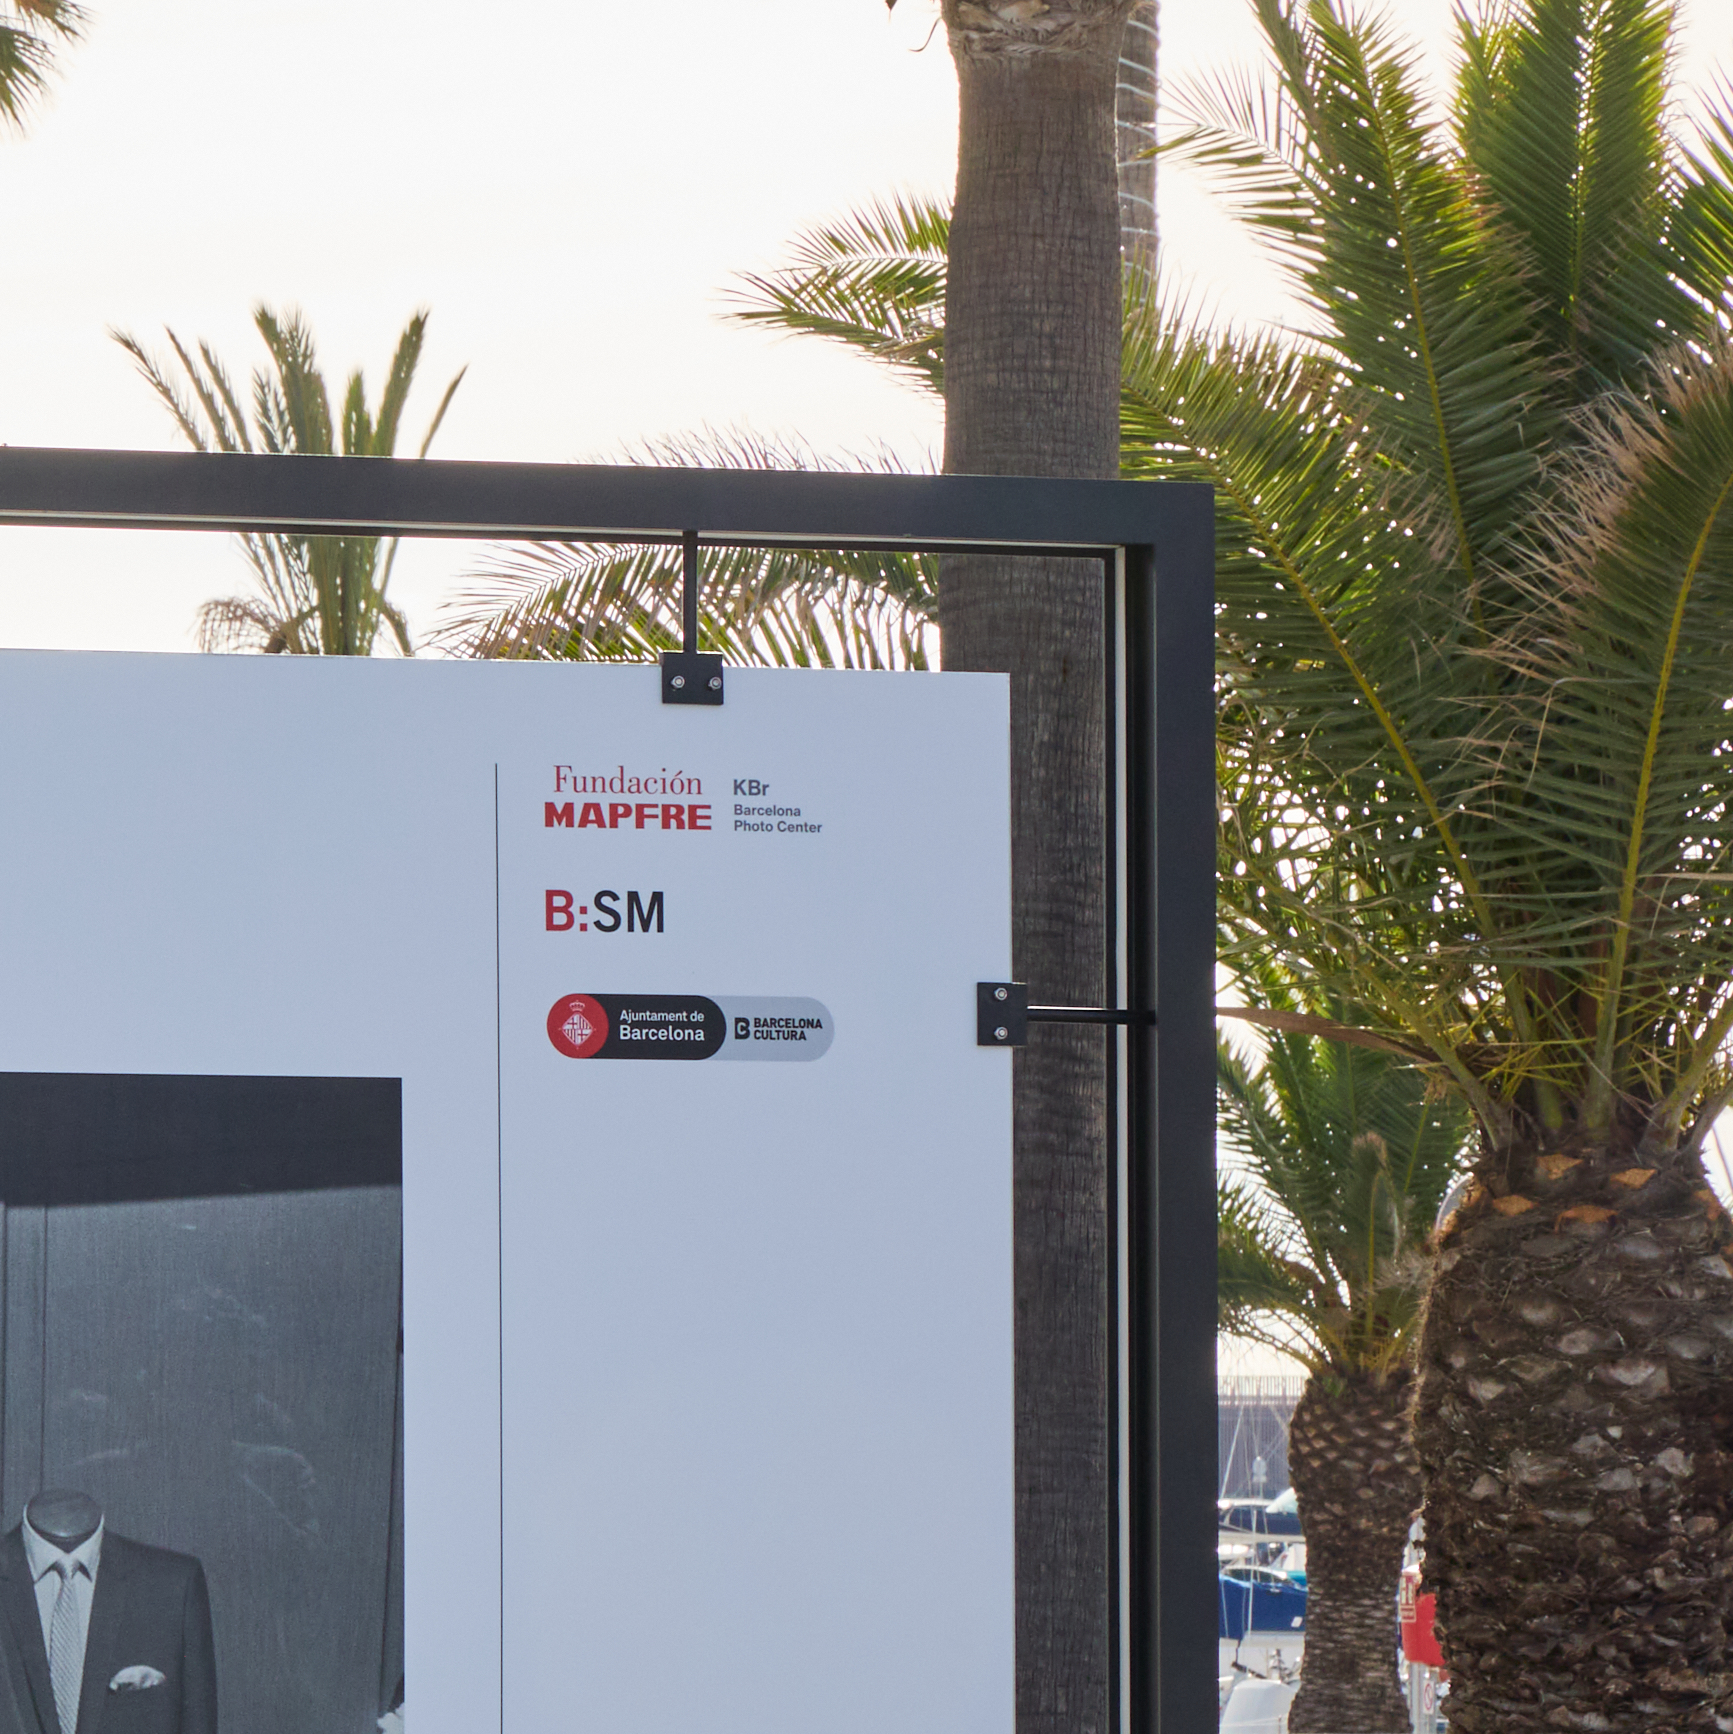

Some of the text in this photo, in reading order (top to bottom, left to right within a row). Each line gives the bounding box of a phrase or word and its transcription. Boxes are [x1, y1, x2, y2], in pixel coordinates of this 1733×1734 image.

[555, 766, 702, 795] Fundación
[734, 779, 769, 796] KBr
[545, 802, 711, 830] MAPFRE
[734, 804, 801, 817] Barcelona
[734, 820, 822, 833] Photo Center
[546, 890, 664, 933] B:SM
[620, 1010, 704, 1023] Ajuntament de
[754, 1018, 823, 1030] BARCELONA
[620, 1025, 704, 1041] Barcelona
[754, 1030, 807, 1041] CULTURA
